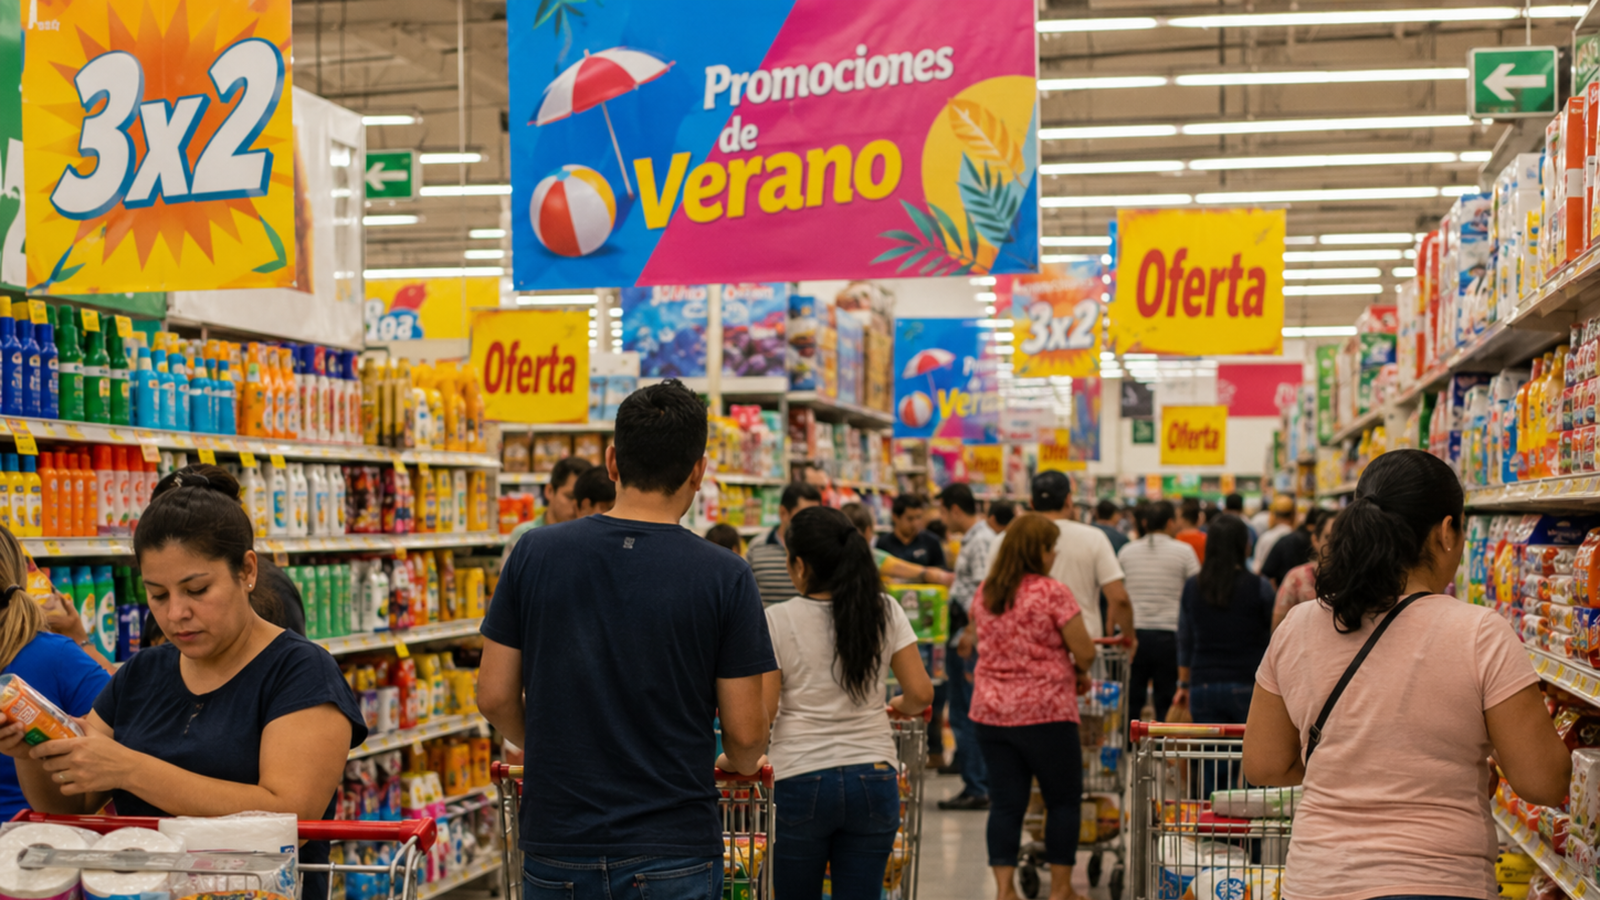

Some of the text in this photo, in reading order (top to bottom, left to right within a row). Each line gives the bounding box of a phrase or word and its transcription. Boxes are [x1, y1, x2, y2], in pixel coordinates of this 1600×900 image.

[704, 45, 954, 109] Promociones
[50, 38, 285, 220] 3x2
[719, 116, 758, 154] de
[633, 140, 902, 229] Verano
[1136, 248, 1265, 318] Oferta
[1020, 298, 1100, 355] 3x2
[484, 339, 576, 395] Oferta
[1167, 419, 1220, 451] Oferta
